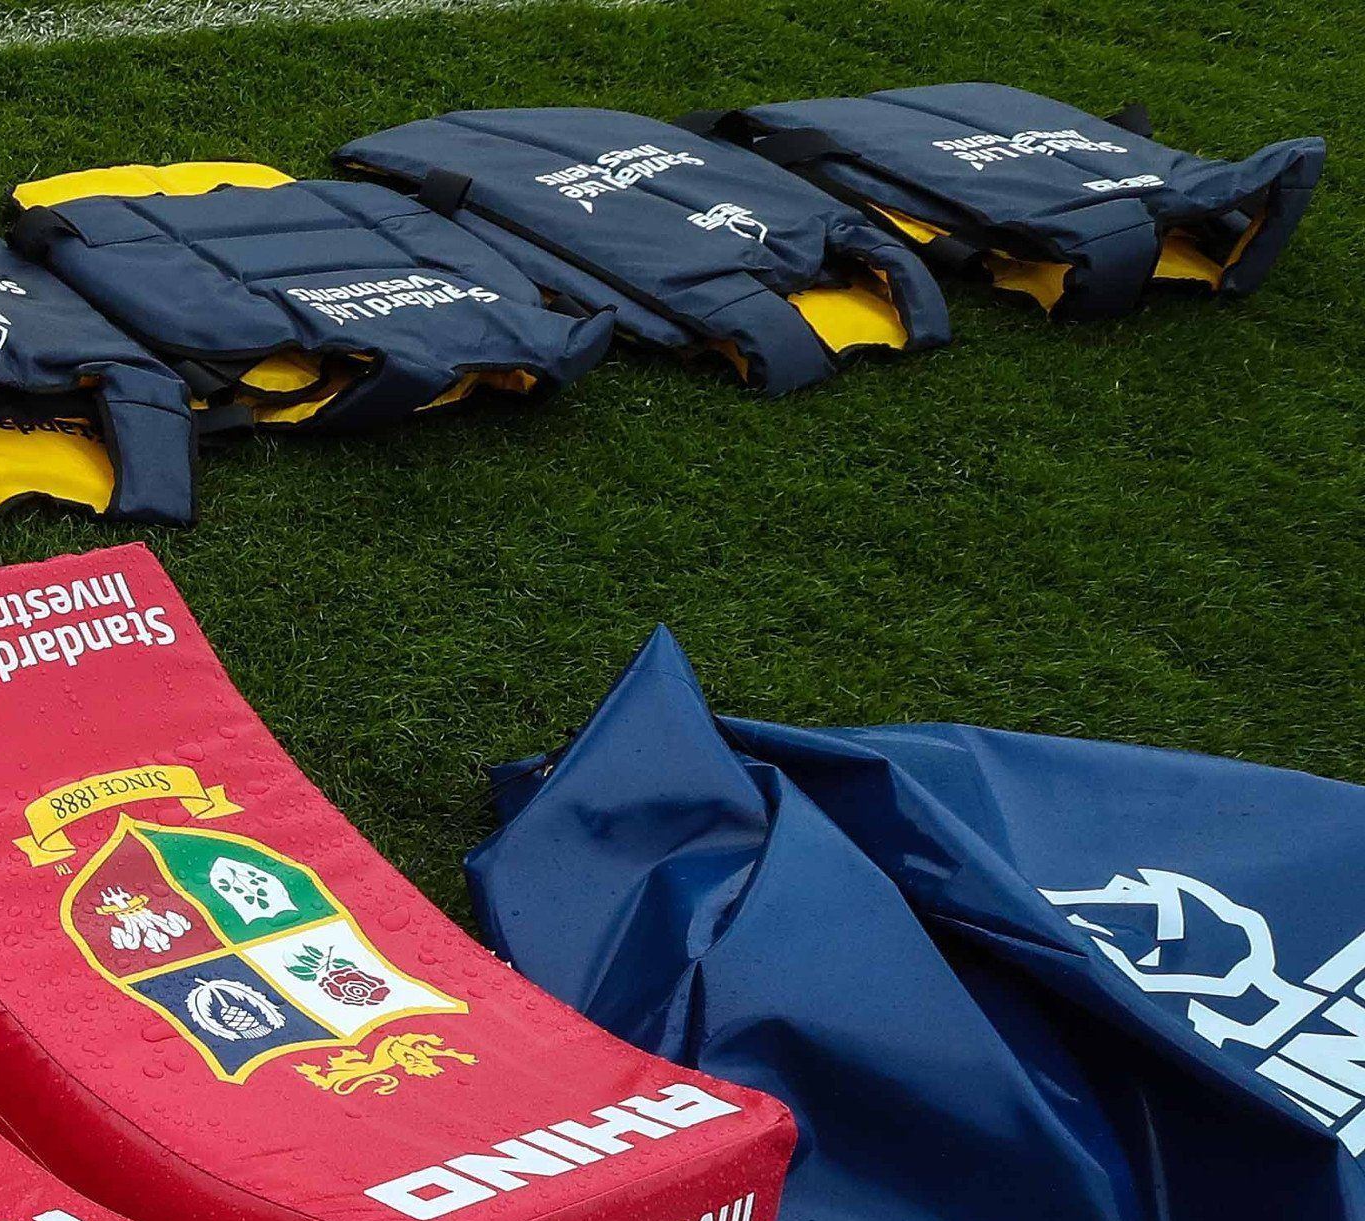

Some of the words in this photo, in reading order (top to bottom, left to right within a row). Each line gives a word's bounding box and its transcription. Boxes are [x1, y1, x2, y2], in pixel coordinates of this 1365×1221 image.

[953, 147, 1019, 162] Life
[559, 175, 617, 200] Life
[287, 275, 447, 303] vestments
[363, 285, 500, 316] Sandard
[98, 770, 172, 797] SINCE
[50, 786, 98, 819] 1888
[364, 1082, 744, 1221] RHINO
